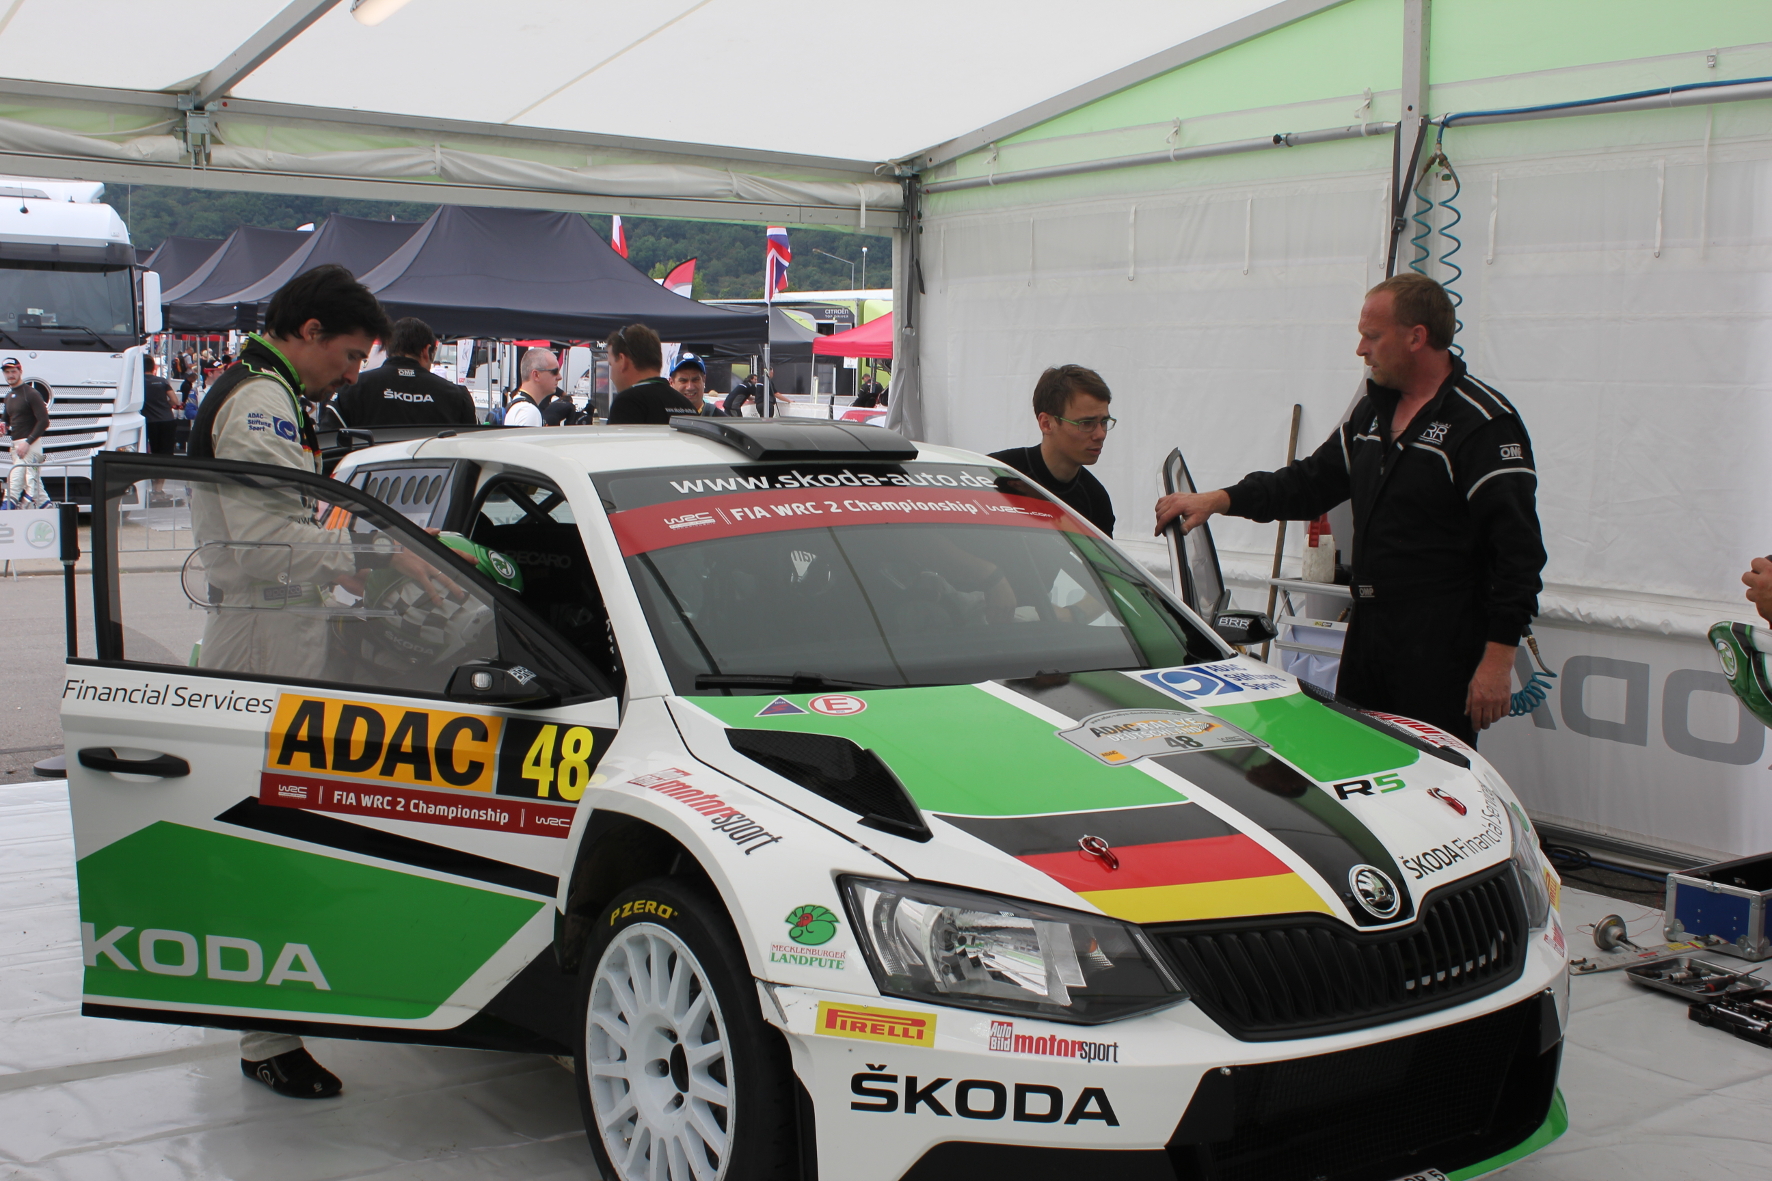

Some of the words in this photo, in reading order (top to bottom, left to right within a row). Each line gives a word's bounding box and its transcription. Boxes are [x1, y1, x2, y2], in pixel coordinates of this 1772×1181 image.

[384, 388, 434, 402] ŠKODA
[248, 419, 272, 428] Stiftung
[669, 470, 998, 494] www.skoda-auto.de
[663, 511, 713, 525] WRC
[729, 506, 772, 521] FIA
[770, 502, 824, 517] WRC
[824, 501, 842, 513] 2
[843, 499, 978, 515] Championship
[1219, 617, 1250, 629] BRR
[62, 679, 170, 706] Financial
[171, 686, 274, 714] Services
[822, 697, 853, 711] E
[1089, 723, 1142, 738] ADAC
[1136, 717, 1198, 730] RALLYE
[1106, 725, 1204, 742] DEUTSCHLAND
[276, 699, 491, 788] ADAC
[521, 724, 594, 802] 48
[1164, 735, 1204, 749] 48
[1333, 773, 1408, 801] R5
[278, 784, 308, 795] WRC
[333, 791, 357, 806] FIA
[361, 793, 392, 810] WRC
[396, 798, 406, 811] 2
[409, 799, 510, 826] Championship
[648, 780, 783, 855] motorsport
[1399, 844, 1464, 880] ŠKODA
[1451, 815, 1503, 858] Financial
[621, 900, 673, 919] ZERO
[82, 921, 331, 991] KODA
[770, 952, 845, 970] LANDPUTE
[771, 944, 846, 959] MECKLENBURGER
[825, 1007, 927, 1040] PIRELLI
[991, 1022, 1012, 1037] Auto
[990, 1037, 1011, 1051] Bild
[1013, 1034, 1119, 1063] motorsport
[850, 1063, 1120, 1127] ŠKODA
